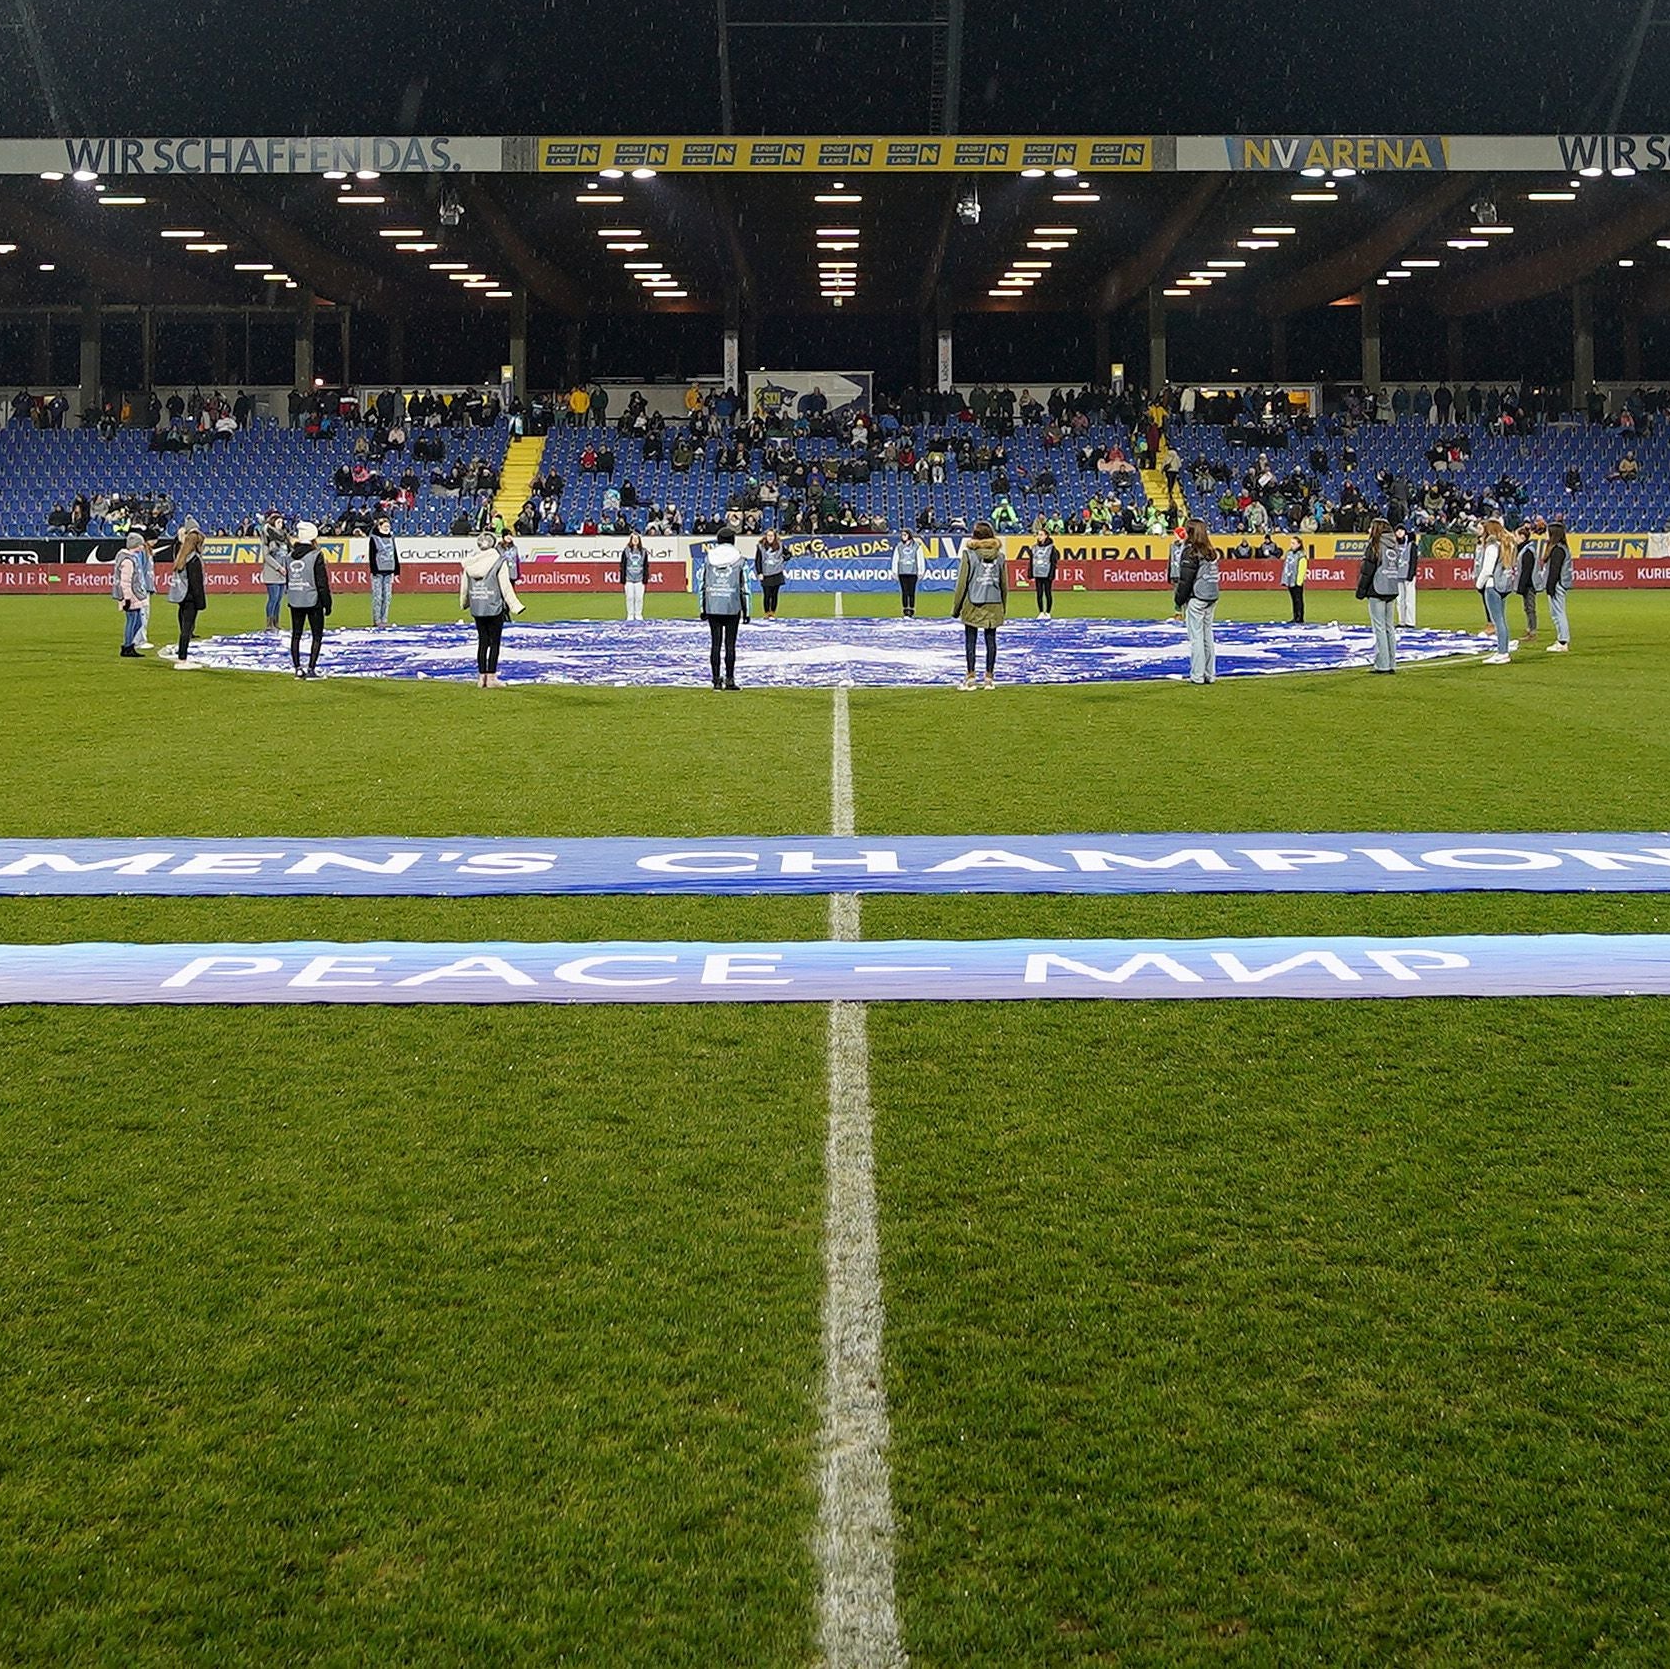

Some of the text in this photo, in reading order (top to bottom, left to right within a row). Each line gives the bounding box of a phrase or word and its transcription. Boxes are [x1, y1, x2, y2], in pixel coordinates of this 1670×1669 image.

[65, 137, 462, 173] WIR SCHAFFEN DAS.
[1304, 139, 1433, 169] ARENA
[1559, 135, 1638, 170] WIR
[862, 538, 893, 554] DAS.
[1584, 540, 1617, 549] SPORT
[517, 570, 591, 586] ournalismus
[783, 569, 959, 582] MEN'S CHAMPION AGUE
[1571, 566, 1624, 582] nalismus
[159, 953, 797, 988] PEACE
